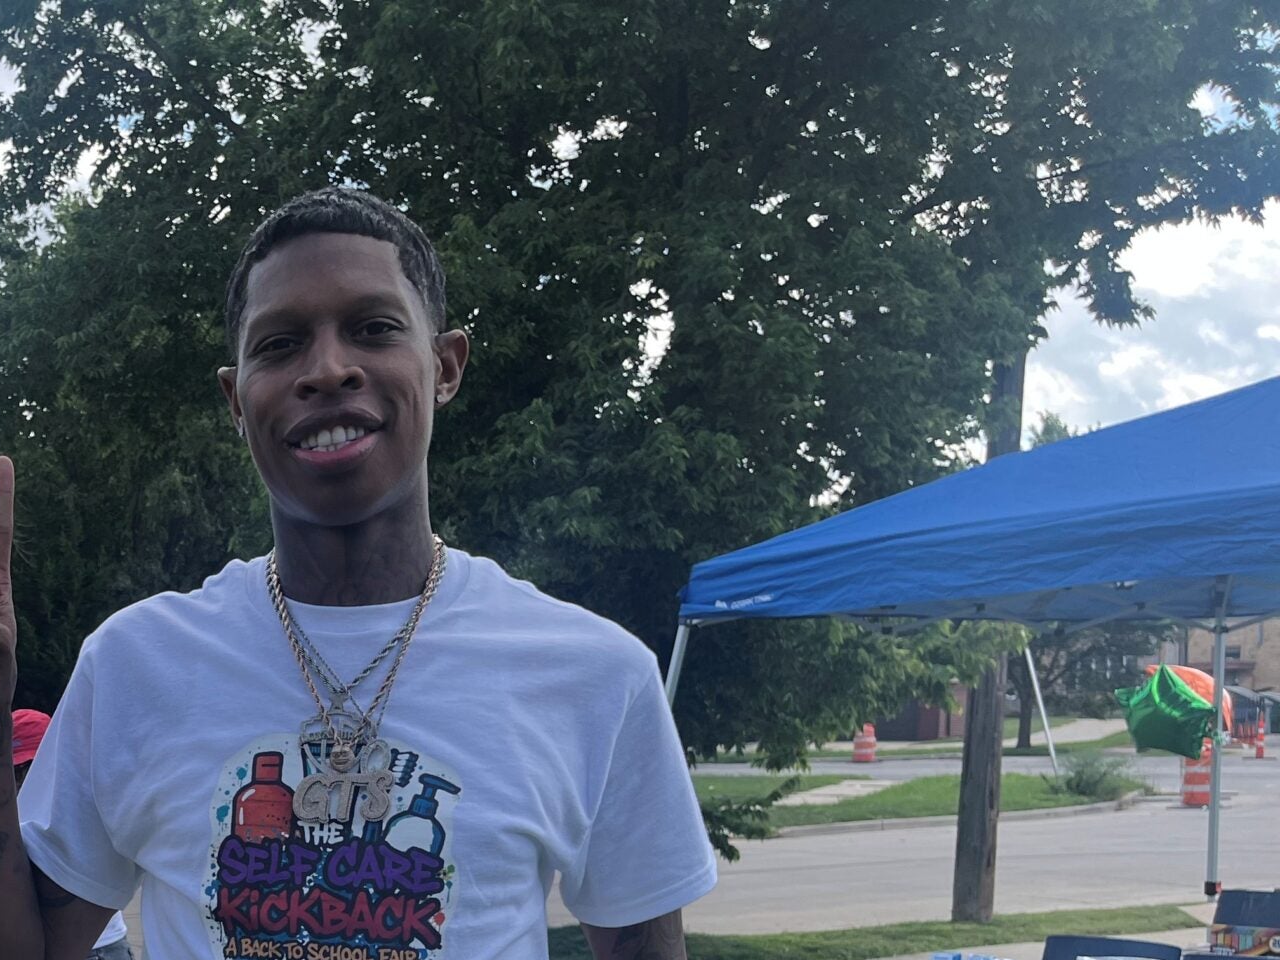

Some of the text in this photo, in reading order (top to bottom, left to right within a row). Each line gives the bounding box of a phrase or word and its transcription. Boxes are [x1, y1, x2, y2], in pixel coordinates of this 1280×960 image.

[297, 820, 344, 845] THE
[220, 839, 444, 893] SELF CARE
[226, 937, 237, 957] A
[241, 938, 281, 960] BACK
[283, 943, 304, 960] TO
